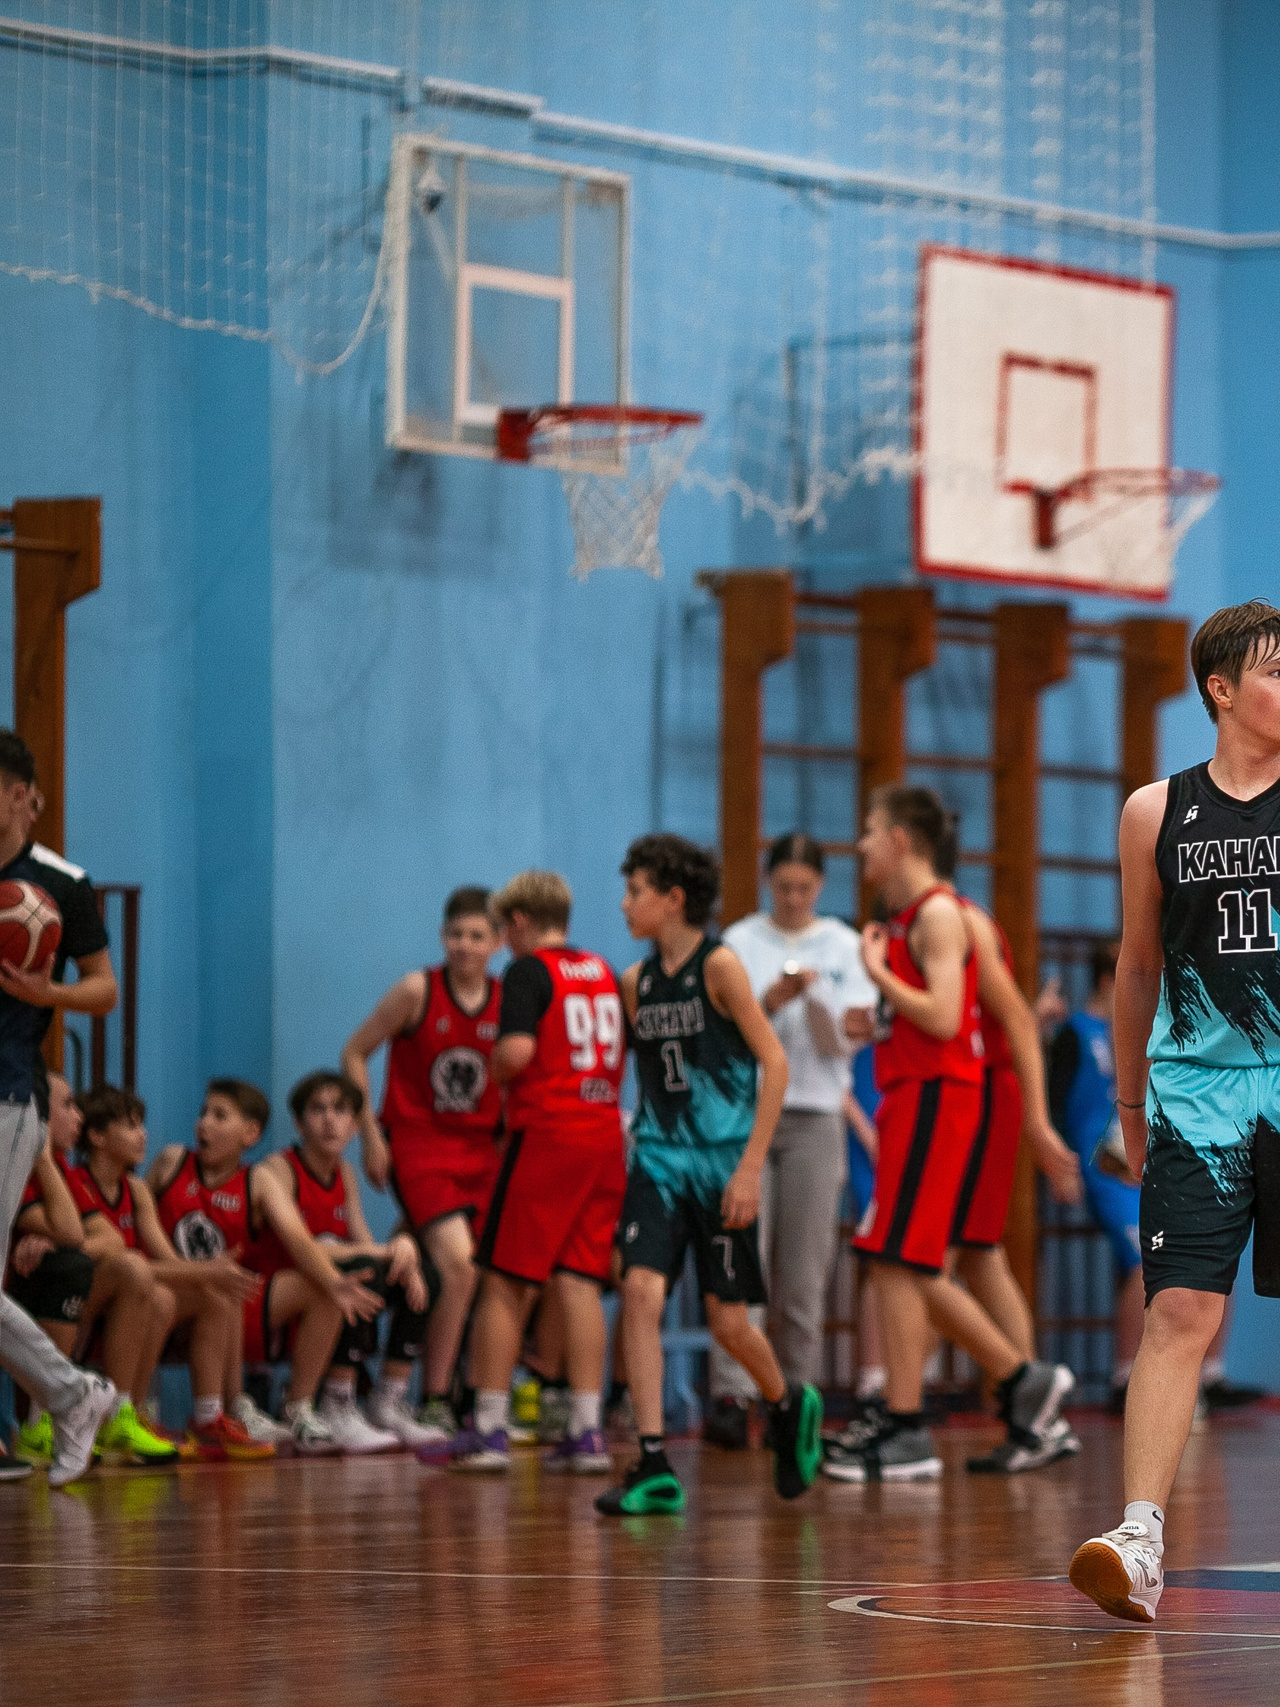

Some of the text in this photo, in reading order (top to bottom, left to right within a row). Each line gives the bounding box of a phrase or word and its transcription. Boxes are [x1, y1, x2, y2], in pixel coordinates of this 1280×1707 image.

[1218, 888, 1279, 954] 11
[563, 993, 626, 1071] 99
[661, 1040, 690, 1092] 1
